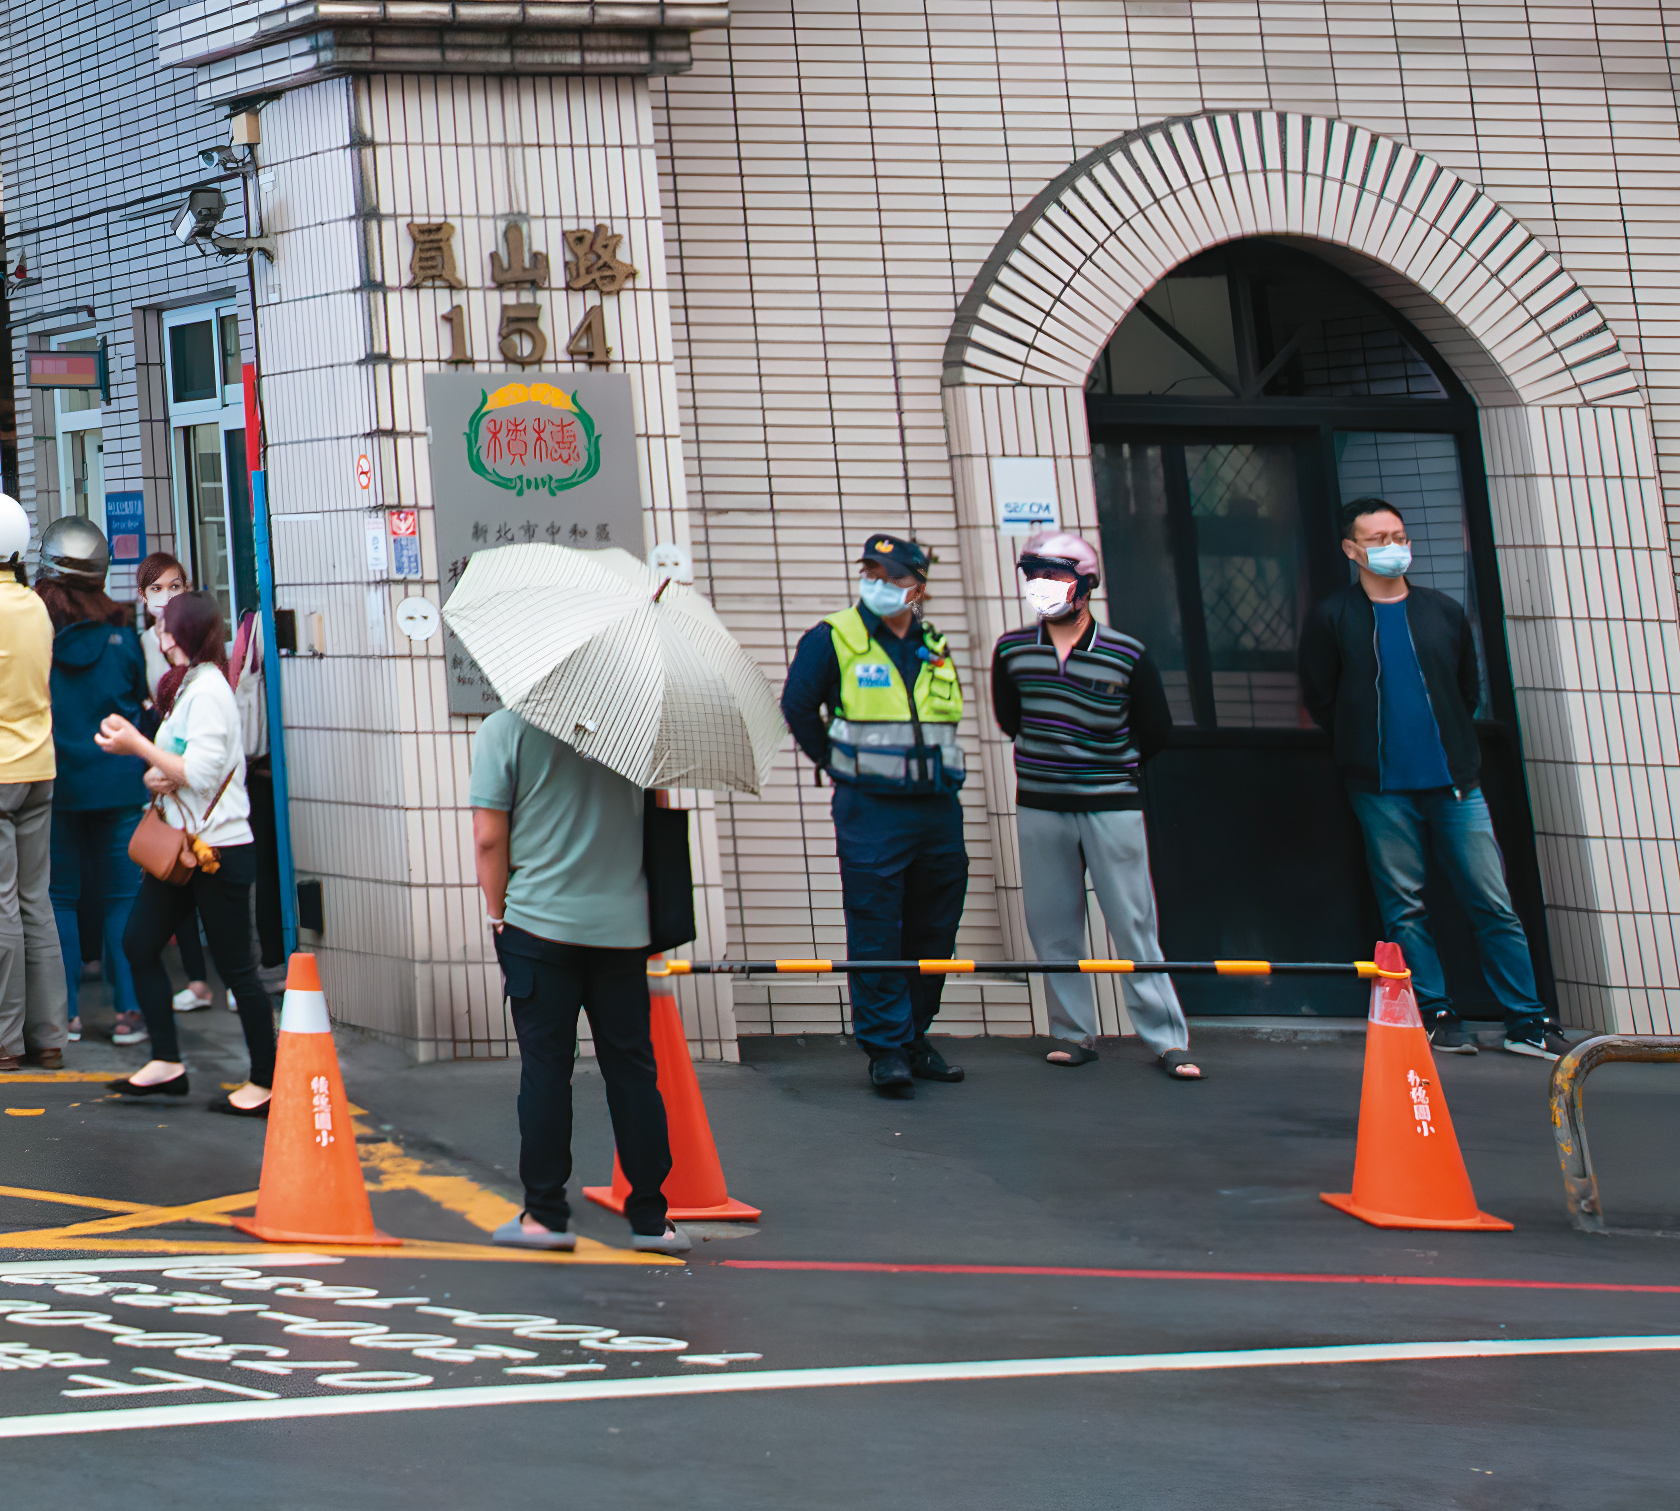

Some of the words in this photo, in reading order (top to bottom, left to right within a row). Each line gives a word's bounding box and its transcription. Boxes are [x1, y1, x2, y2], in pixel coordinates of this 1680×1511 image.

[405, 222, 640, 295] 員山路
[440, 303, 615, 365] 154
[471, 520, 611, 544] 新北市中和區
